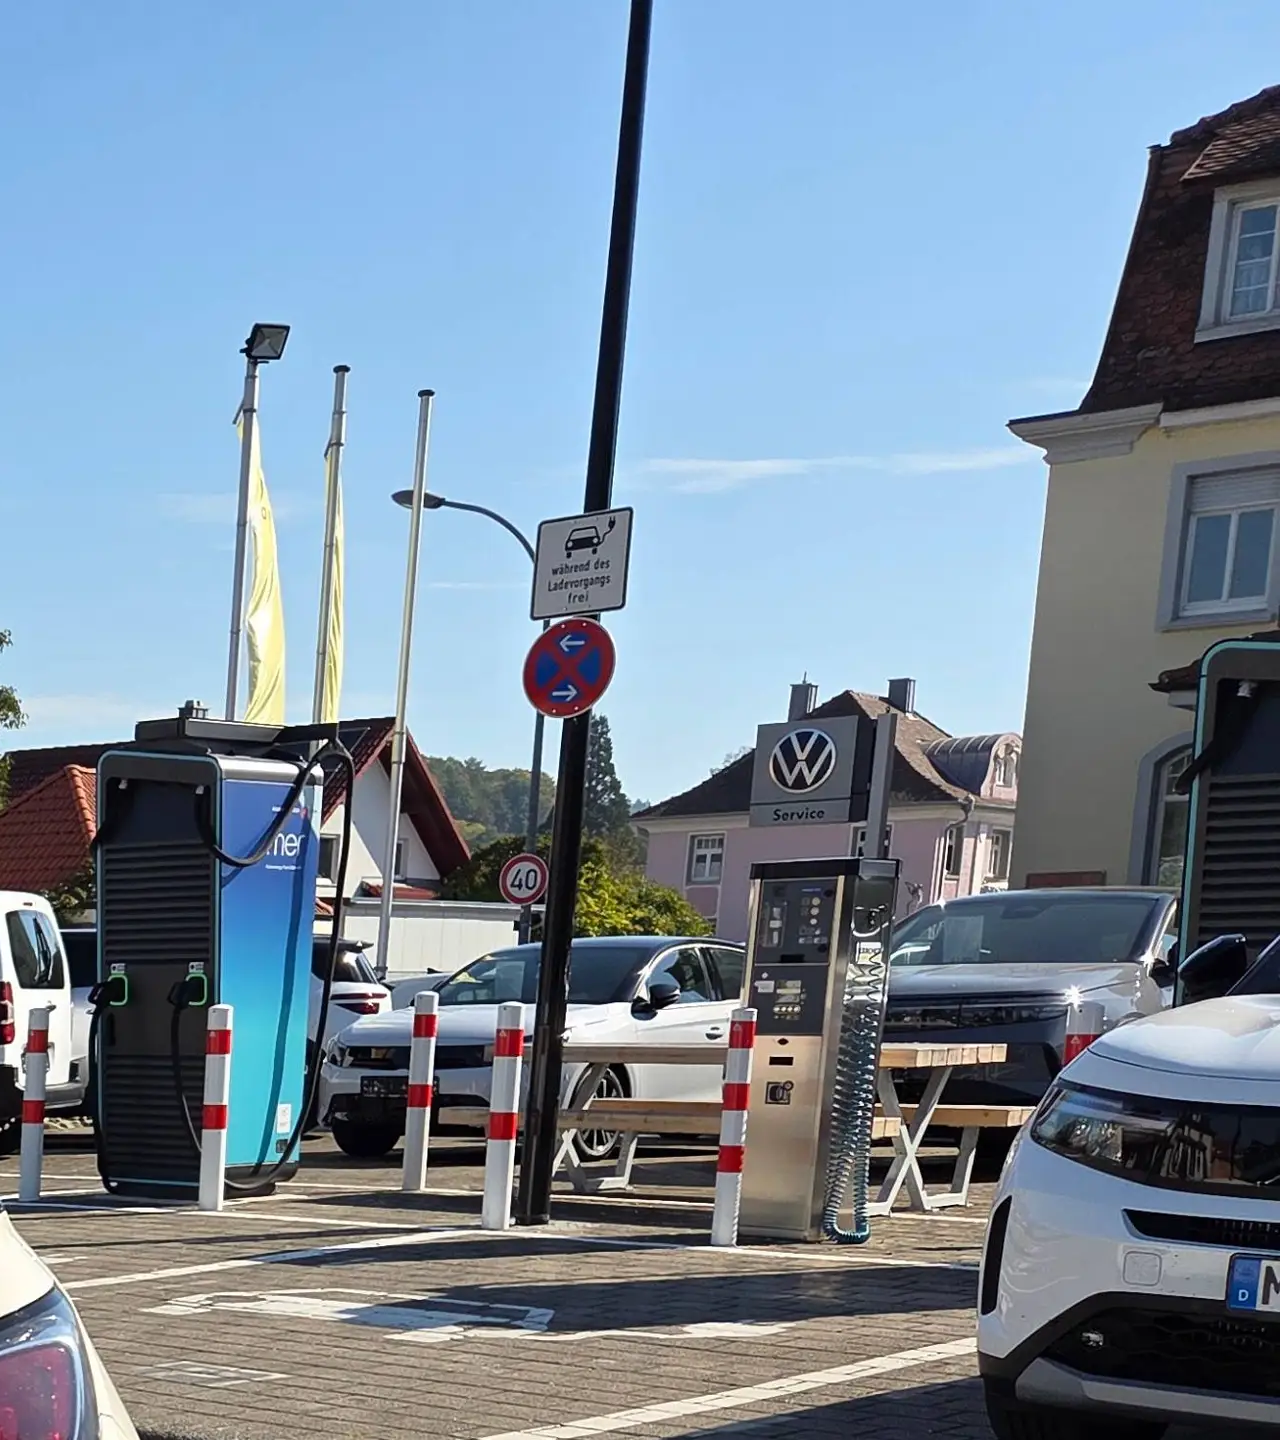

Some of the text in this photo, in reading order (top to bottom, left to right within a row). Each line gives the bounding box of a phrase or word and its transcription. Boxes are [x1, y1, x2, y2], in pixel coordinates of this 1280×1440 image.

[552, 558, 610, 576] während des
[548, 575, 611, 592] Ladevorgangs
[568, 591, 589, 604] frei
[773, 807, 825, 822] Service
[510, 868, 538, 891] 40
[1238, 1289, 1249, 1301] D
